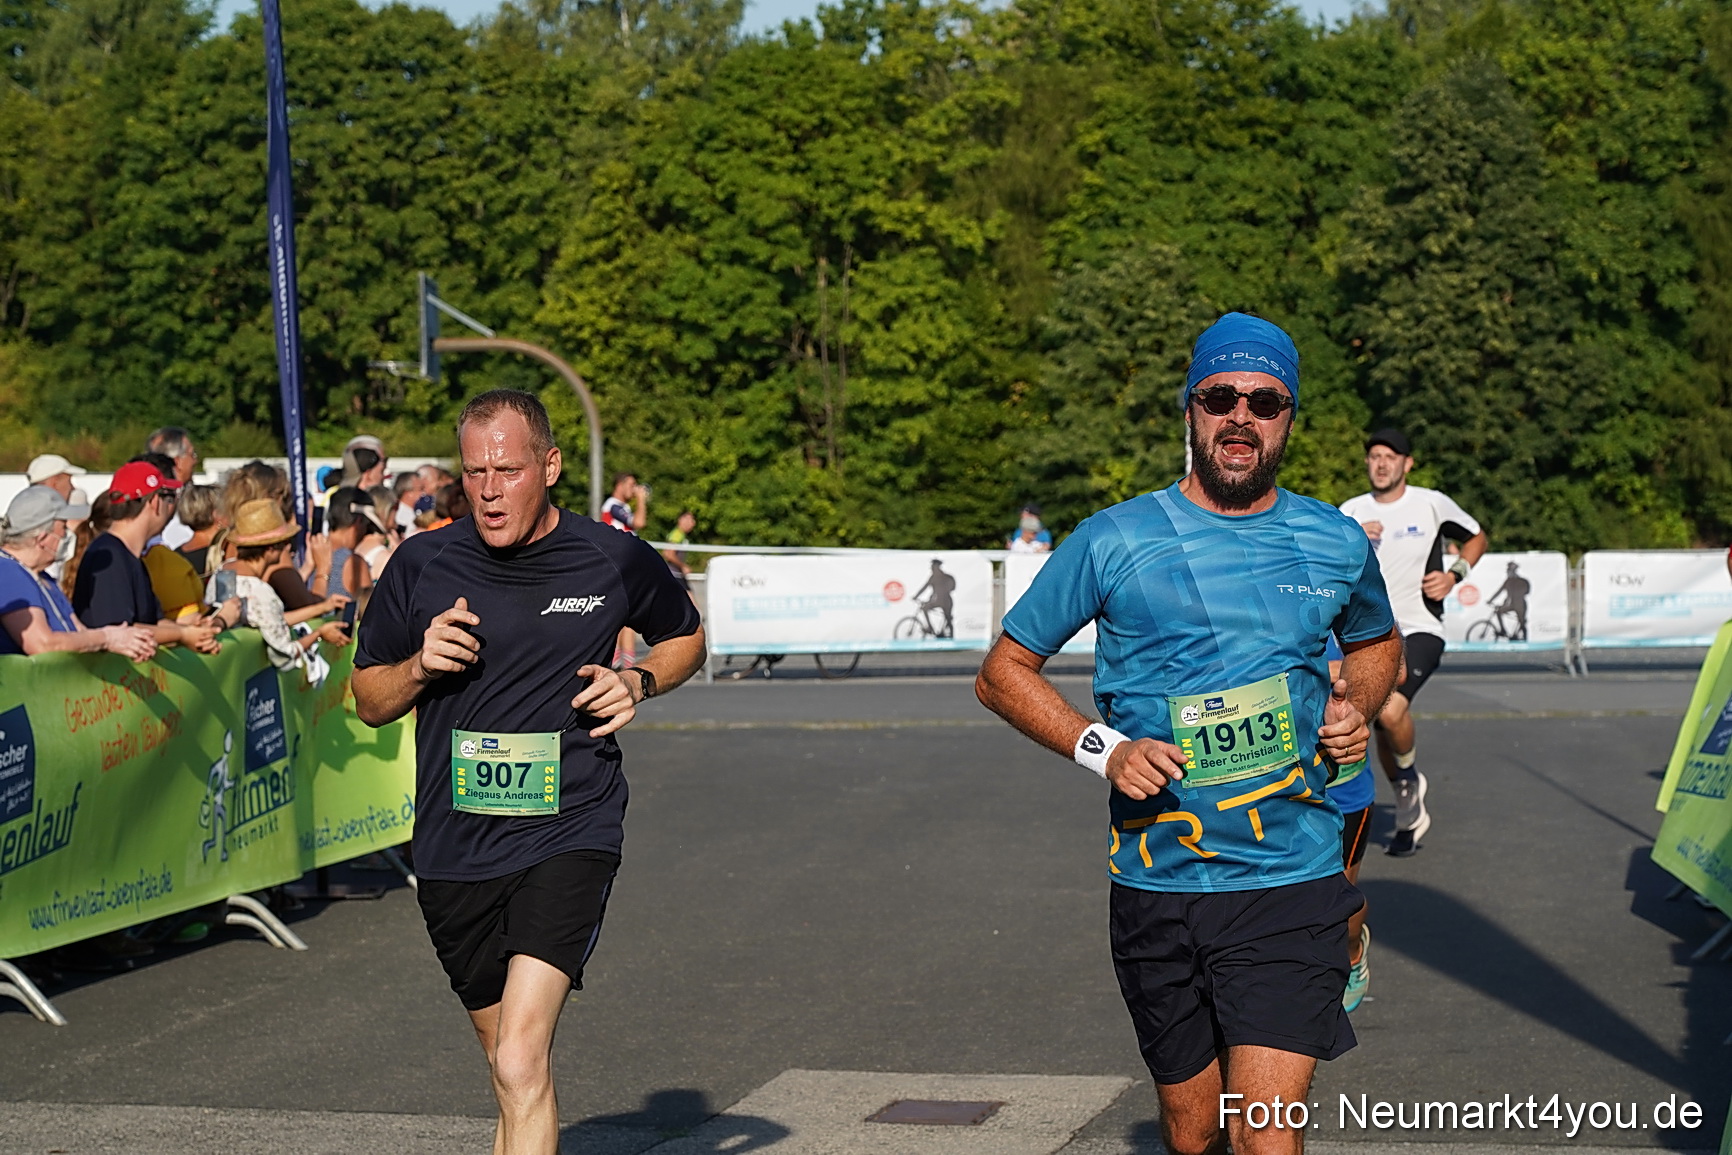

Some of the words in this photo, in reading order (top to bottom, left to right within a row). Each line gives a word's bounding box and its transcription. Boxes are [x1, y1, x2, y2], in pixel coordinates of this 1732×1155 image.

[1232, 352, 1287, 376] PLAST
[1276, 584, 1294, 594] TR
[1298, 585, 1337, 598] PLAST
[540, 597, 588, 615] JURA
[1201, 704, 1239, 718] Firmenlauf
[1195, 711, 1278, 755] 1913
[1277, 710, 1293, 752] 2022
[1181, 738, 1197, 770] RUN
[1200, 757, 1228, 769] Beer
[1230, 743, 1280, 764] Christian
[457, 767, 466, 796] RUN
[476, 761, 532, 788] 907
[544, 766, 555, 803] 2022
[465, 788, 501, 800] Ziegaus
[504, 791, 544, 800] Andreas
[0, 781, 83, 874] enlauf
